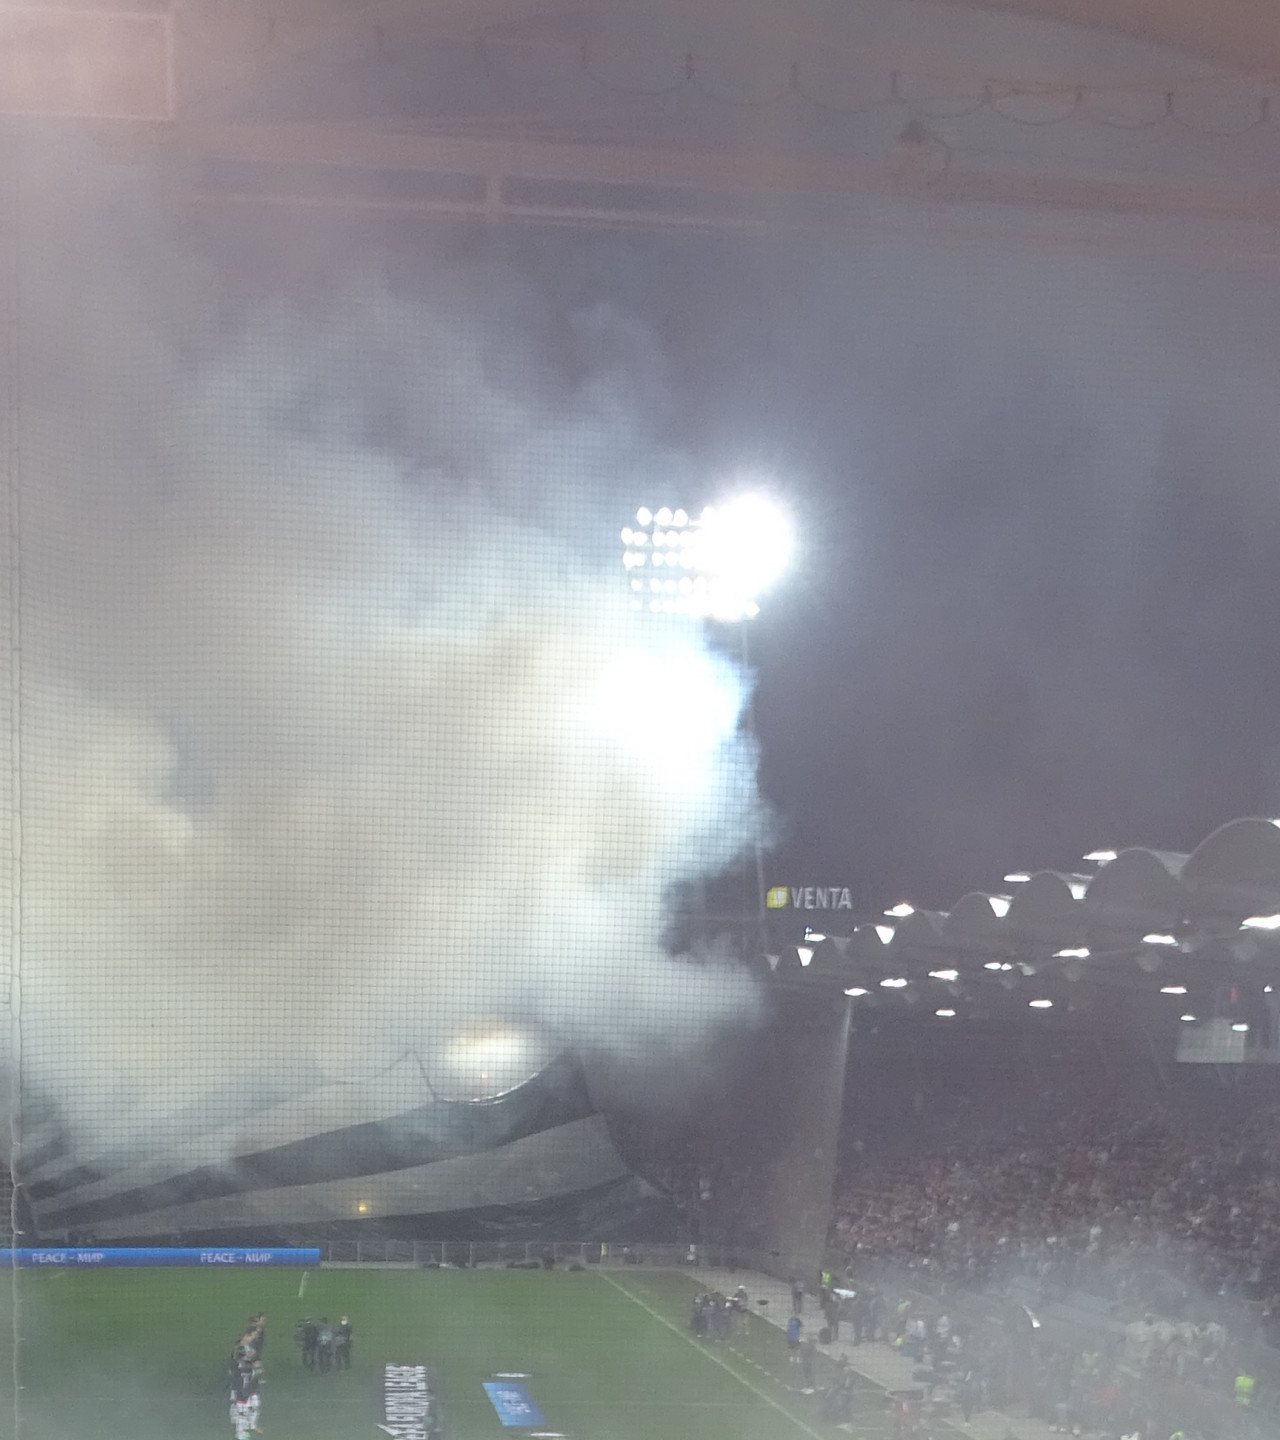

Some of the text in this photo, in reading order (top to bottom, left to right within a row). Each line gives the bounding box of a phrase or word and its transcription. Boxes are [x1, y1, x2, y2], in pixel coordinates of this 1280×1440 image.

[791, 887, 852, 909] VENTA
[32, 1253, 66, 1263] PEACE
[200, 1253, 235, 1263] PEACE
